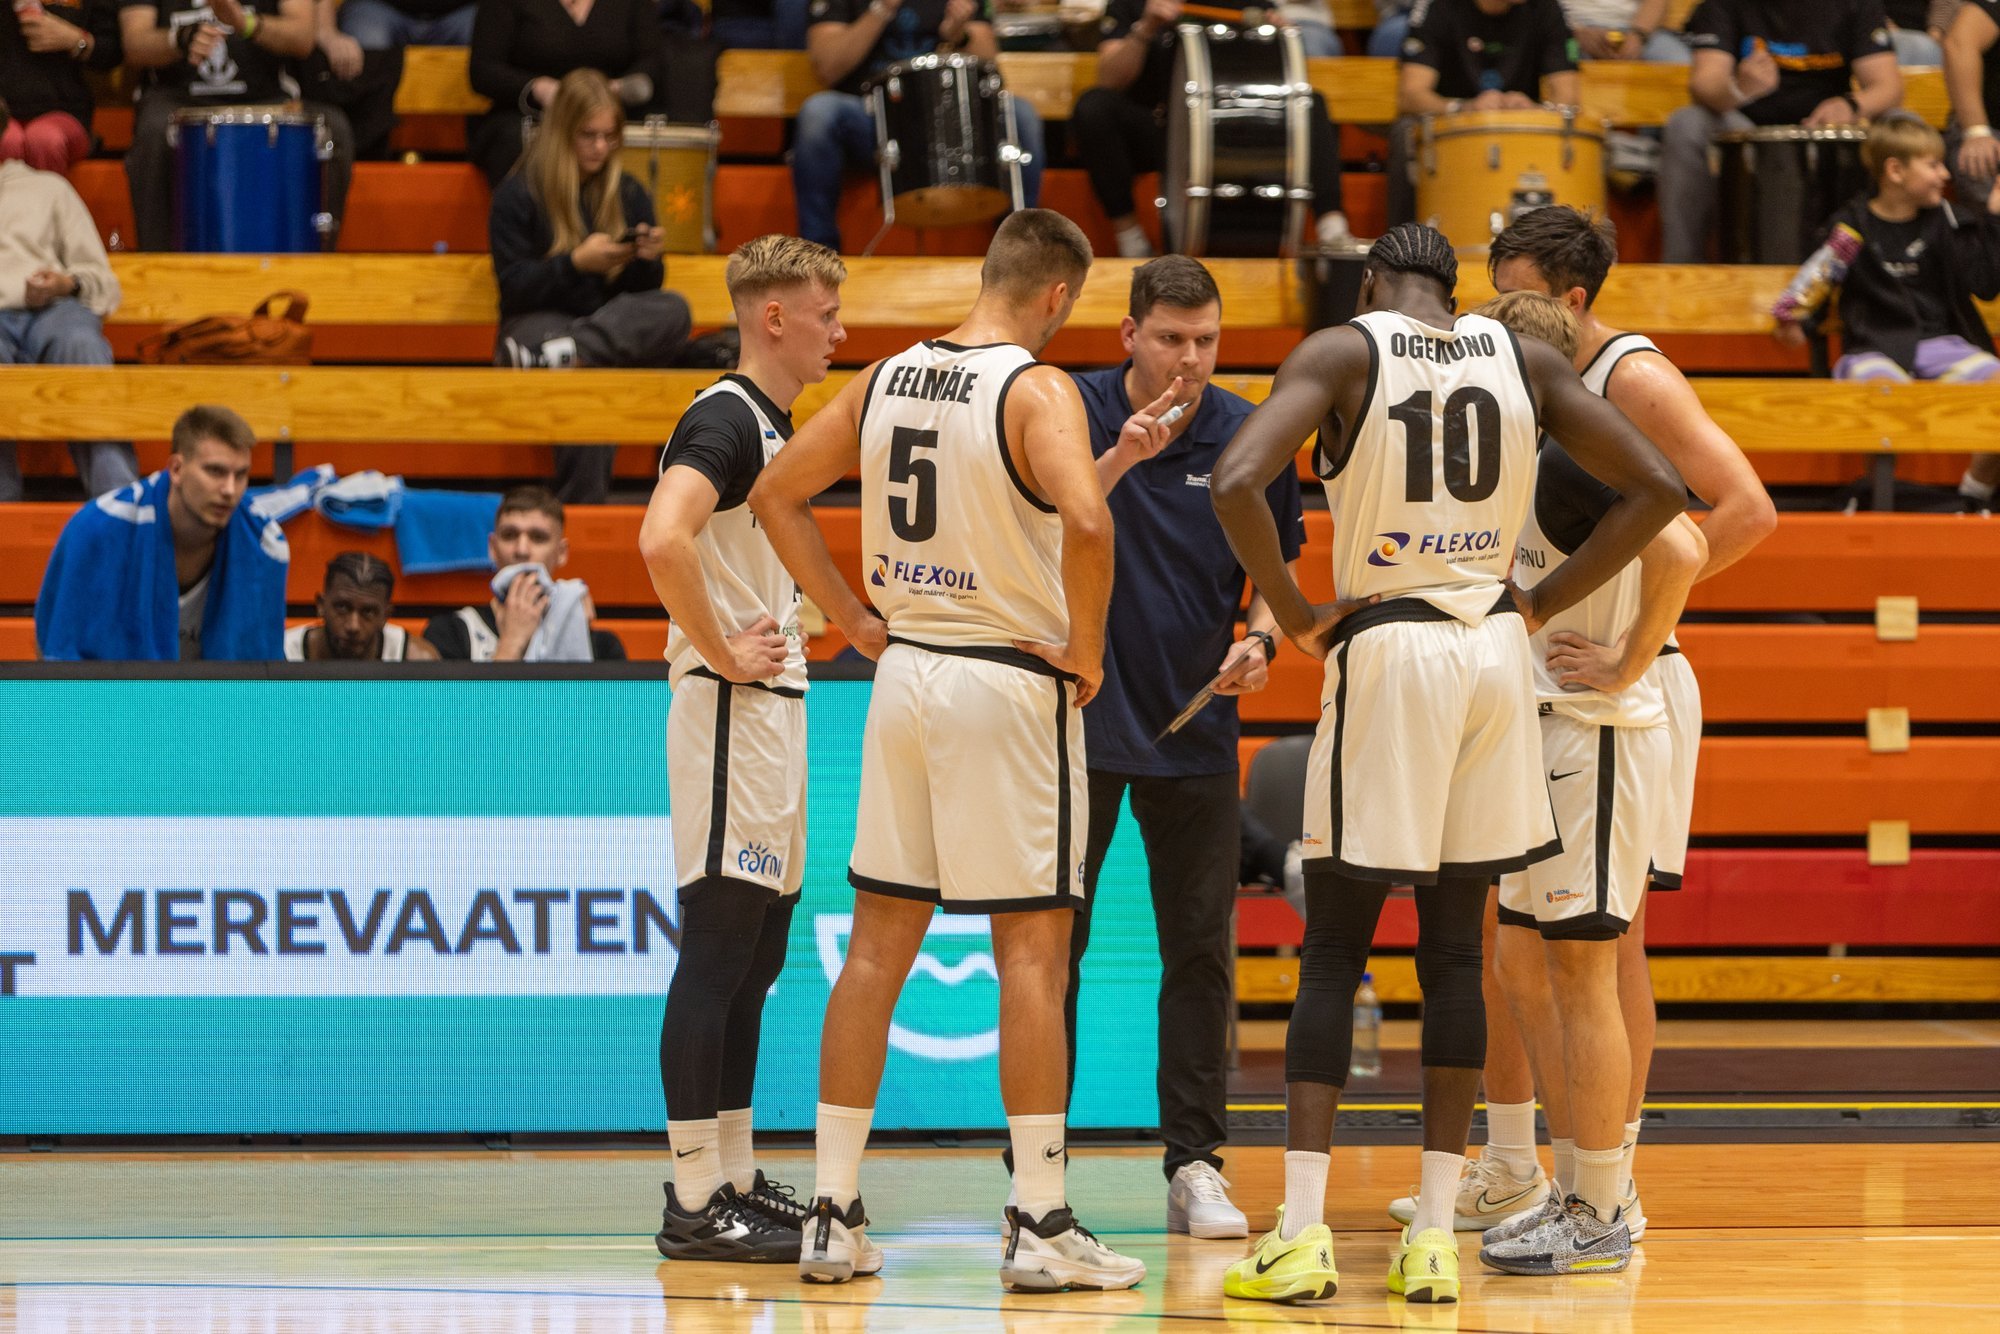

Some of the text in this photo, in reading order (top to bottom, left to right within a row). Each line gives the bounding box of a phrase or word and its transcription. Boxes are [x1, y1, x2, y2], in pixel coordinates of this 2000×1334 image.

[885, 365, 979, 404] EELMÄE
[1388, 386, 1501, 503] 10
[888, 426, 938, 543] 5
[894, 561, 978, 591] FLEXOIL
